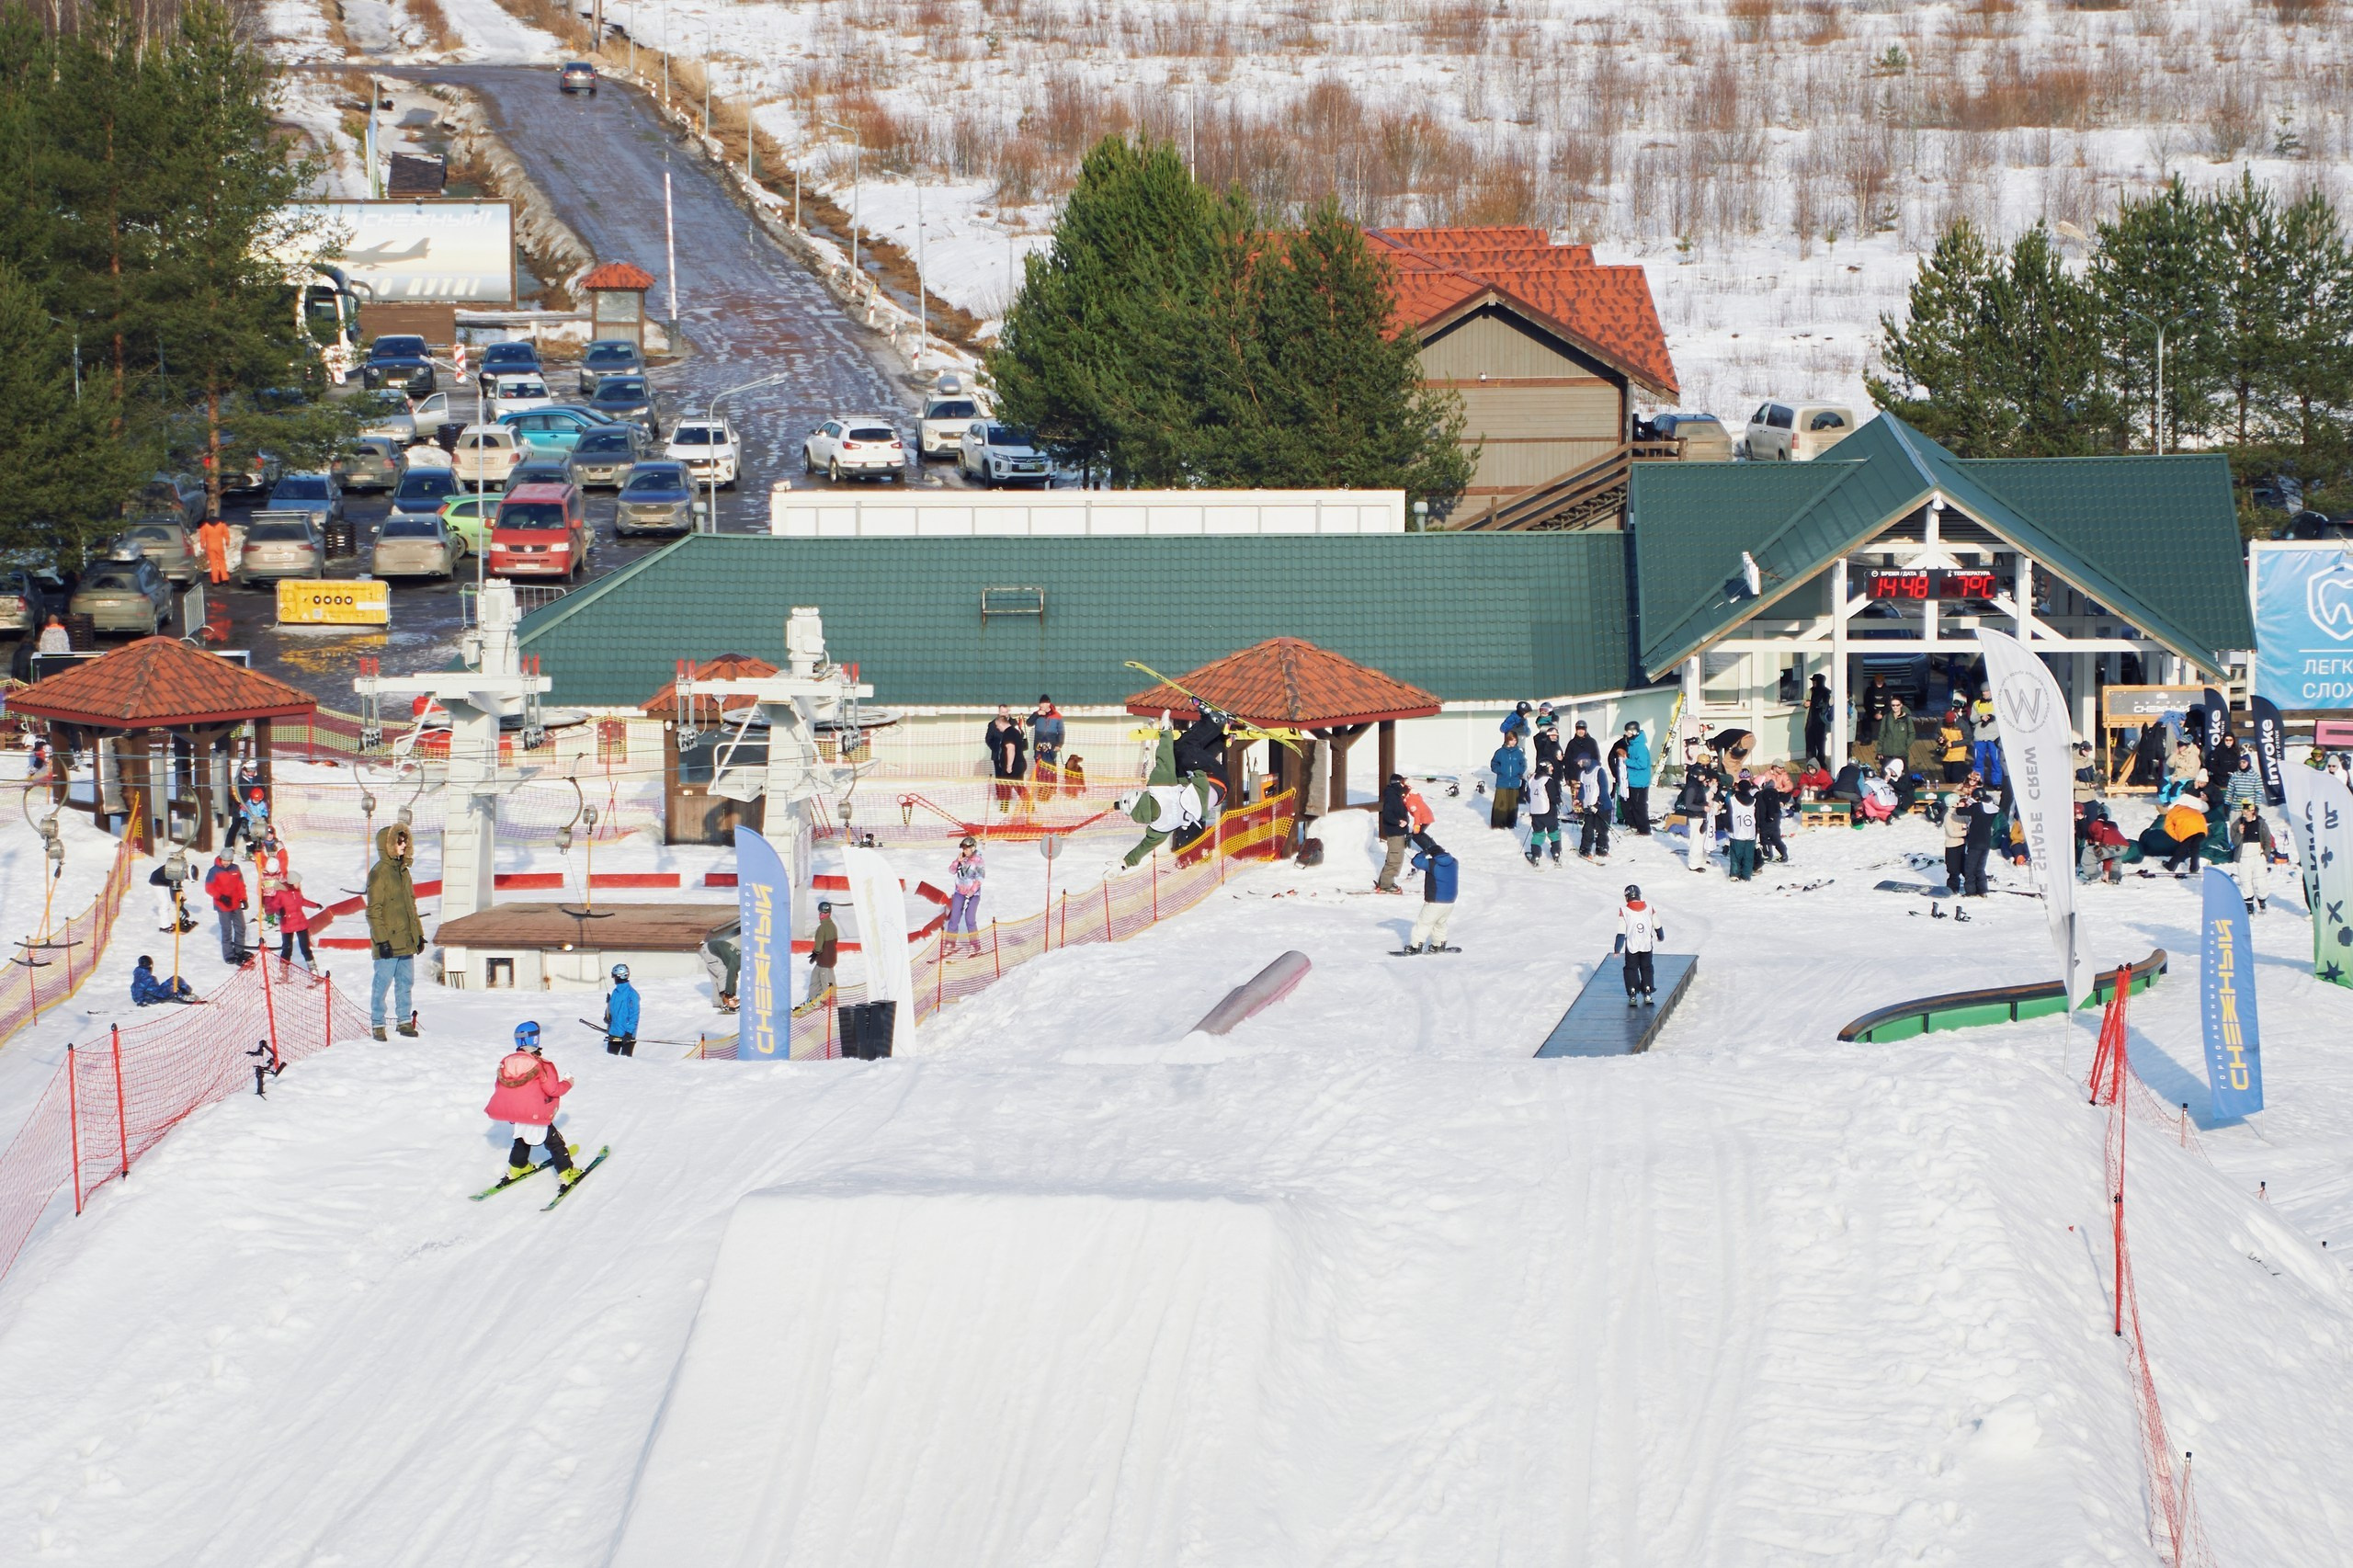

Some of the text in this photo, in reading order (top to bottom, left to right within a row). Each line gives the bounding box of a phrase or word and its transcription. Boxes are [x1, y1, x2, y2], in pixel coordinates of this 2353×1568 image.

[363, 210, 492, 228] СНЕЖНЫЙ!
[406, 278, 481, 296] ПУТИ!
[2261, 719, 2279, 785] invoke
[1533, 789, 1540, 797] 4
[1736, 814, 1753, 827] 16
[1637, 923, 1644, 933] 9
[752, 882, 775, 1054] СНЕЖНЫЙ
[2215, 919, 2249, 1090] СНЕЖНЫЙ
[2209, 983, 2227, 1089] ГОРНОЛЫЖНЫЙ
